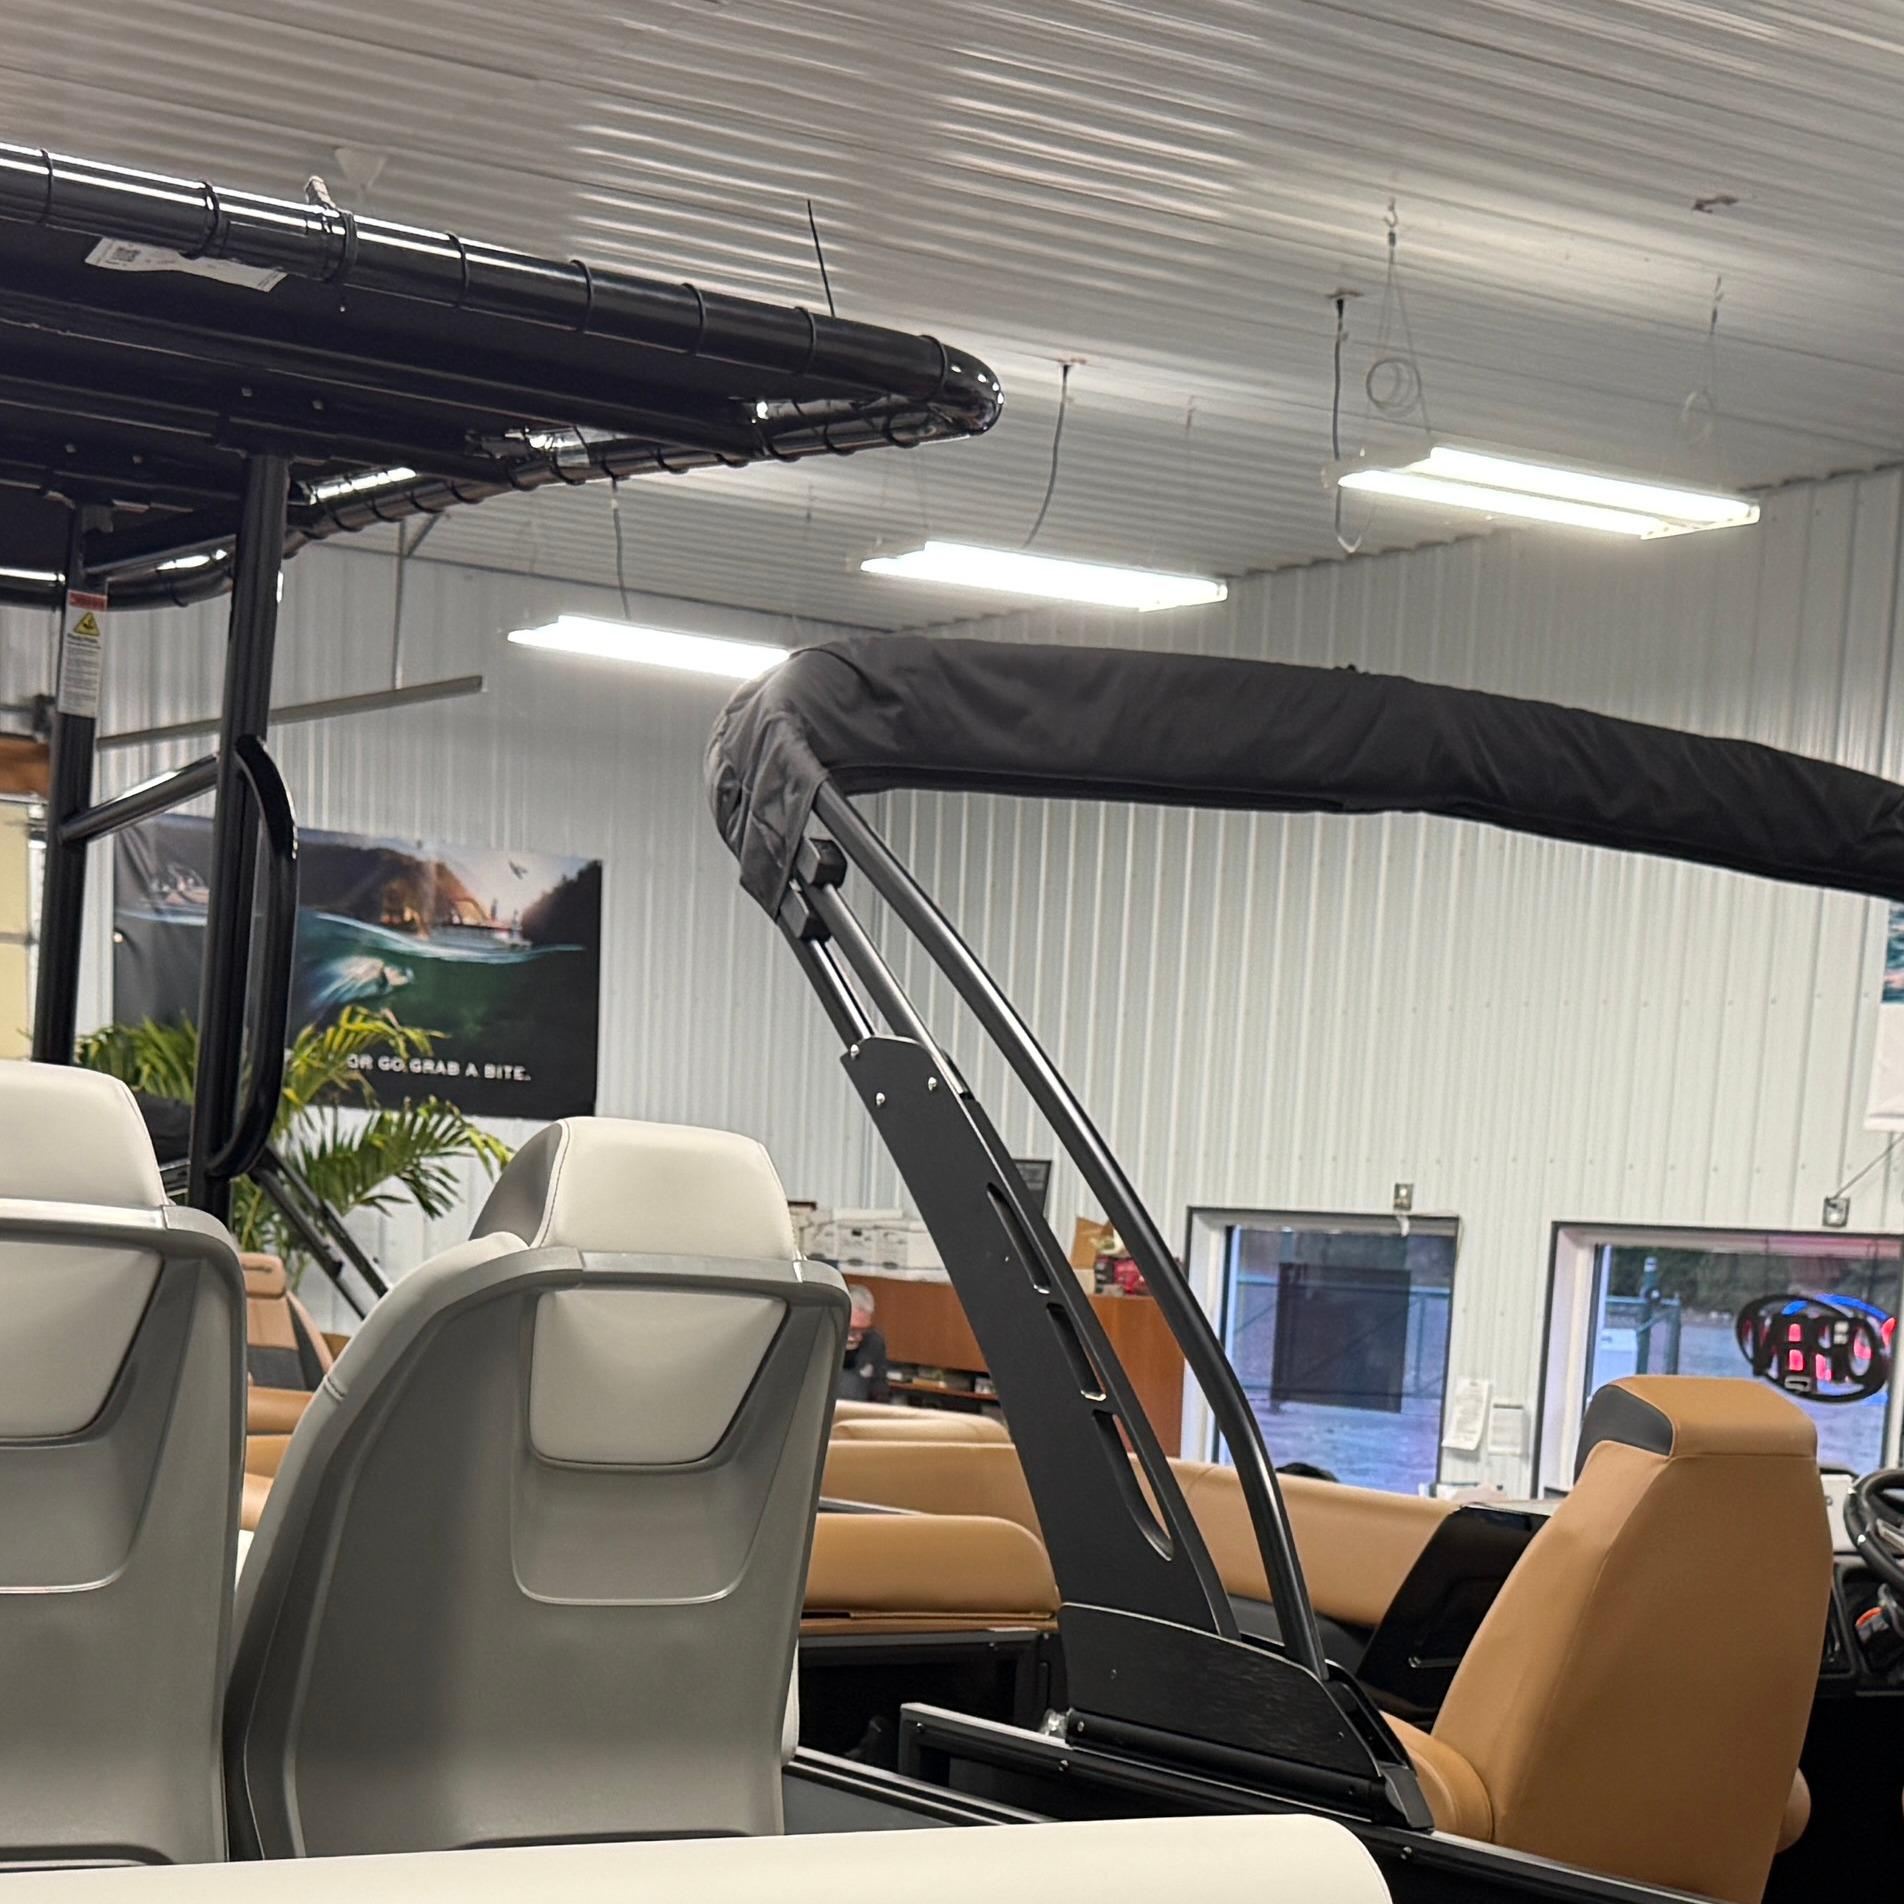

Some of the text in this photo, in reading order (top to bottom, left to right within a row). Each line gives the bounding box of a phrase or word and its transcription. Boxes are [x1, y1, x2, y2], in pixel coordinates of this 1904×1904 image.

[378, 1055, 405, 1073] GO
[409, 1058, 461, 1077] GRAB
[464, 1062, 480, 1079] A
[483, 1063, 532, 1082] BITE.
